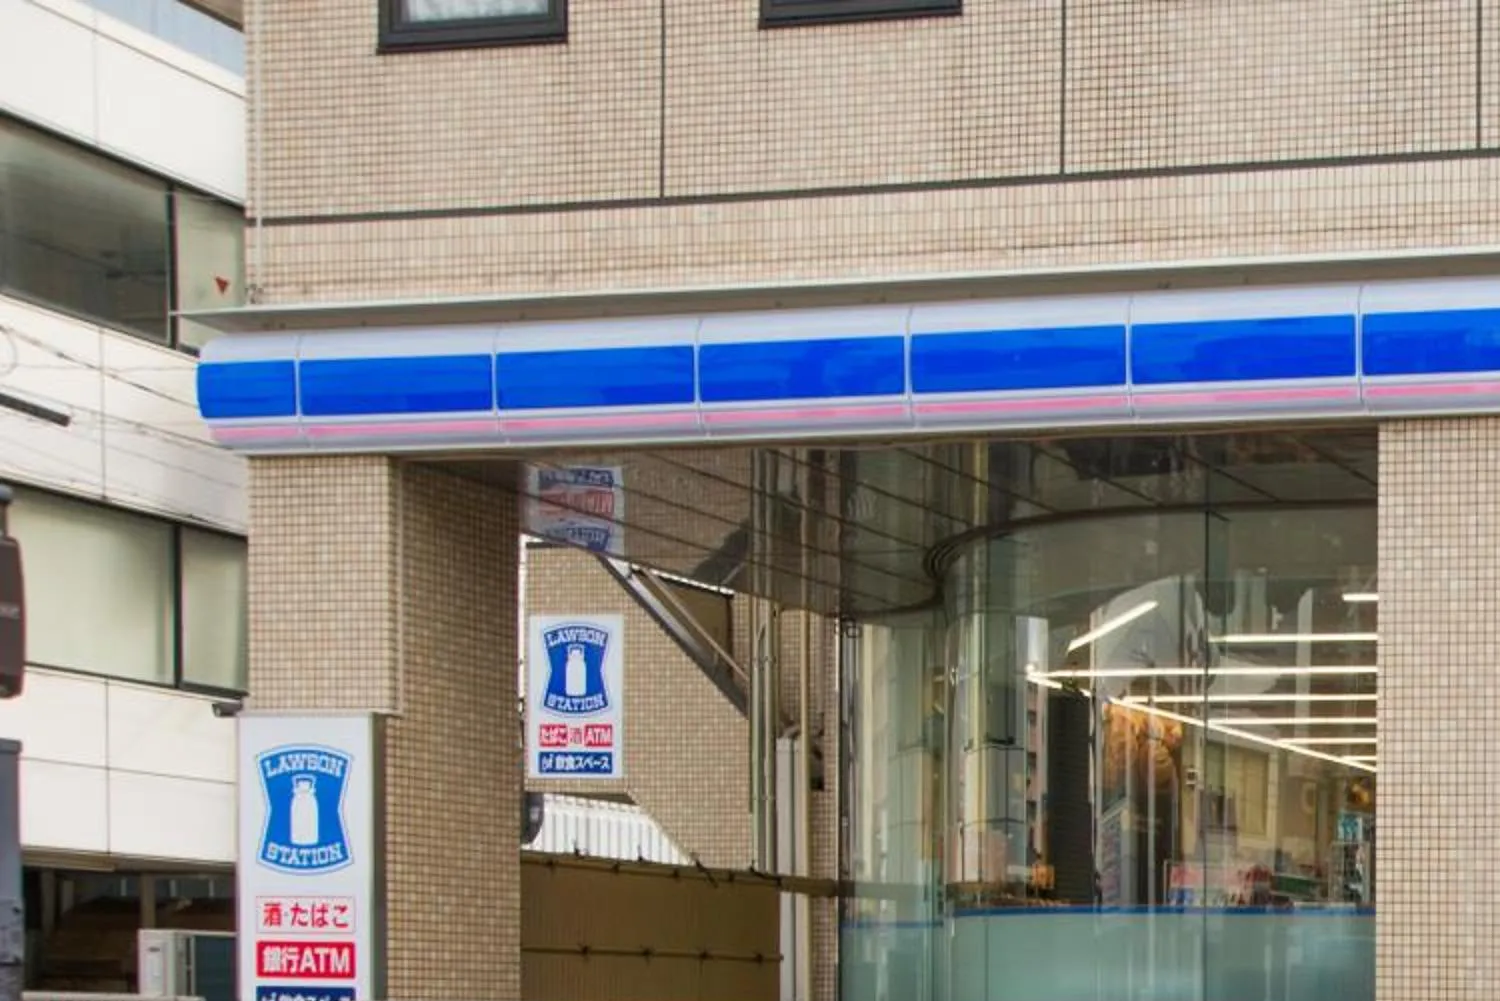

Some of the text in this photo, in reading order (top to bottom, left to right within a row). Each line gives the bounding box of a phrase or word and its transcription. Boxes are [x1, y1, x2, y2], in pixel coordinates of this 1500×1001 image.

[547, 628, 606, 646] LAWSON
[547, 693, 605, 712] STATION
[584, 727, 611, 744] ATM
[264, 754, 344, 777] LAWSON
[265, 842, 343, 866] STATION
[262, 945, 350, 974] 銀行ATM
